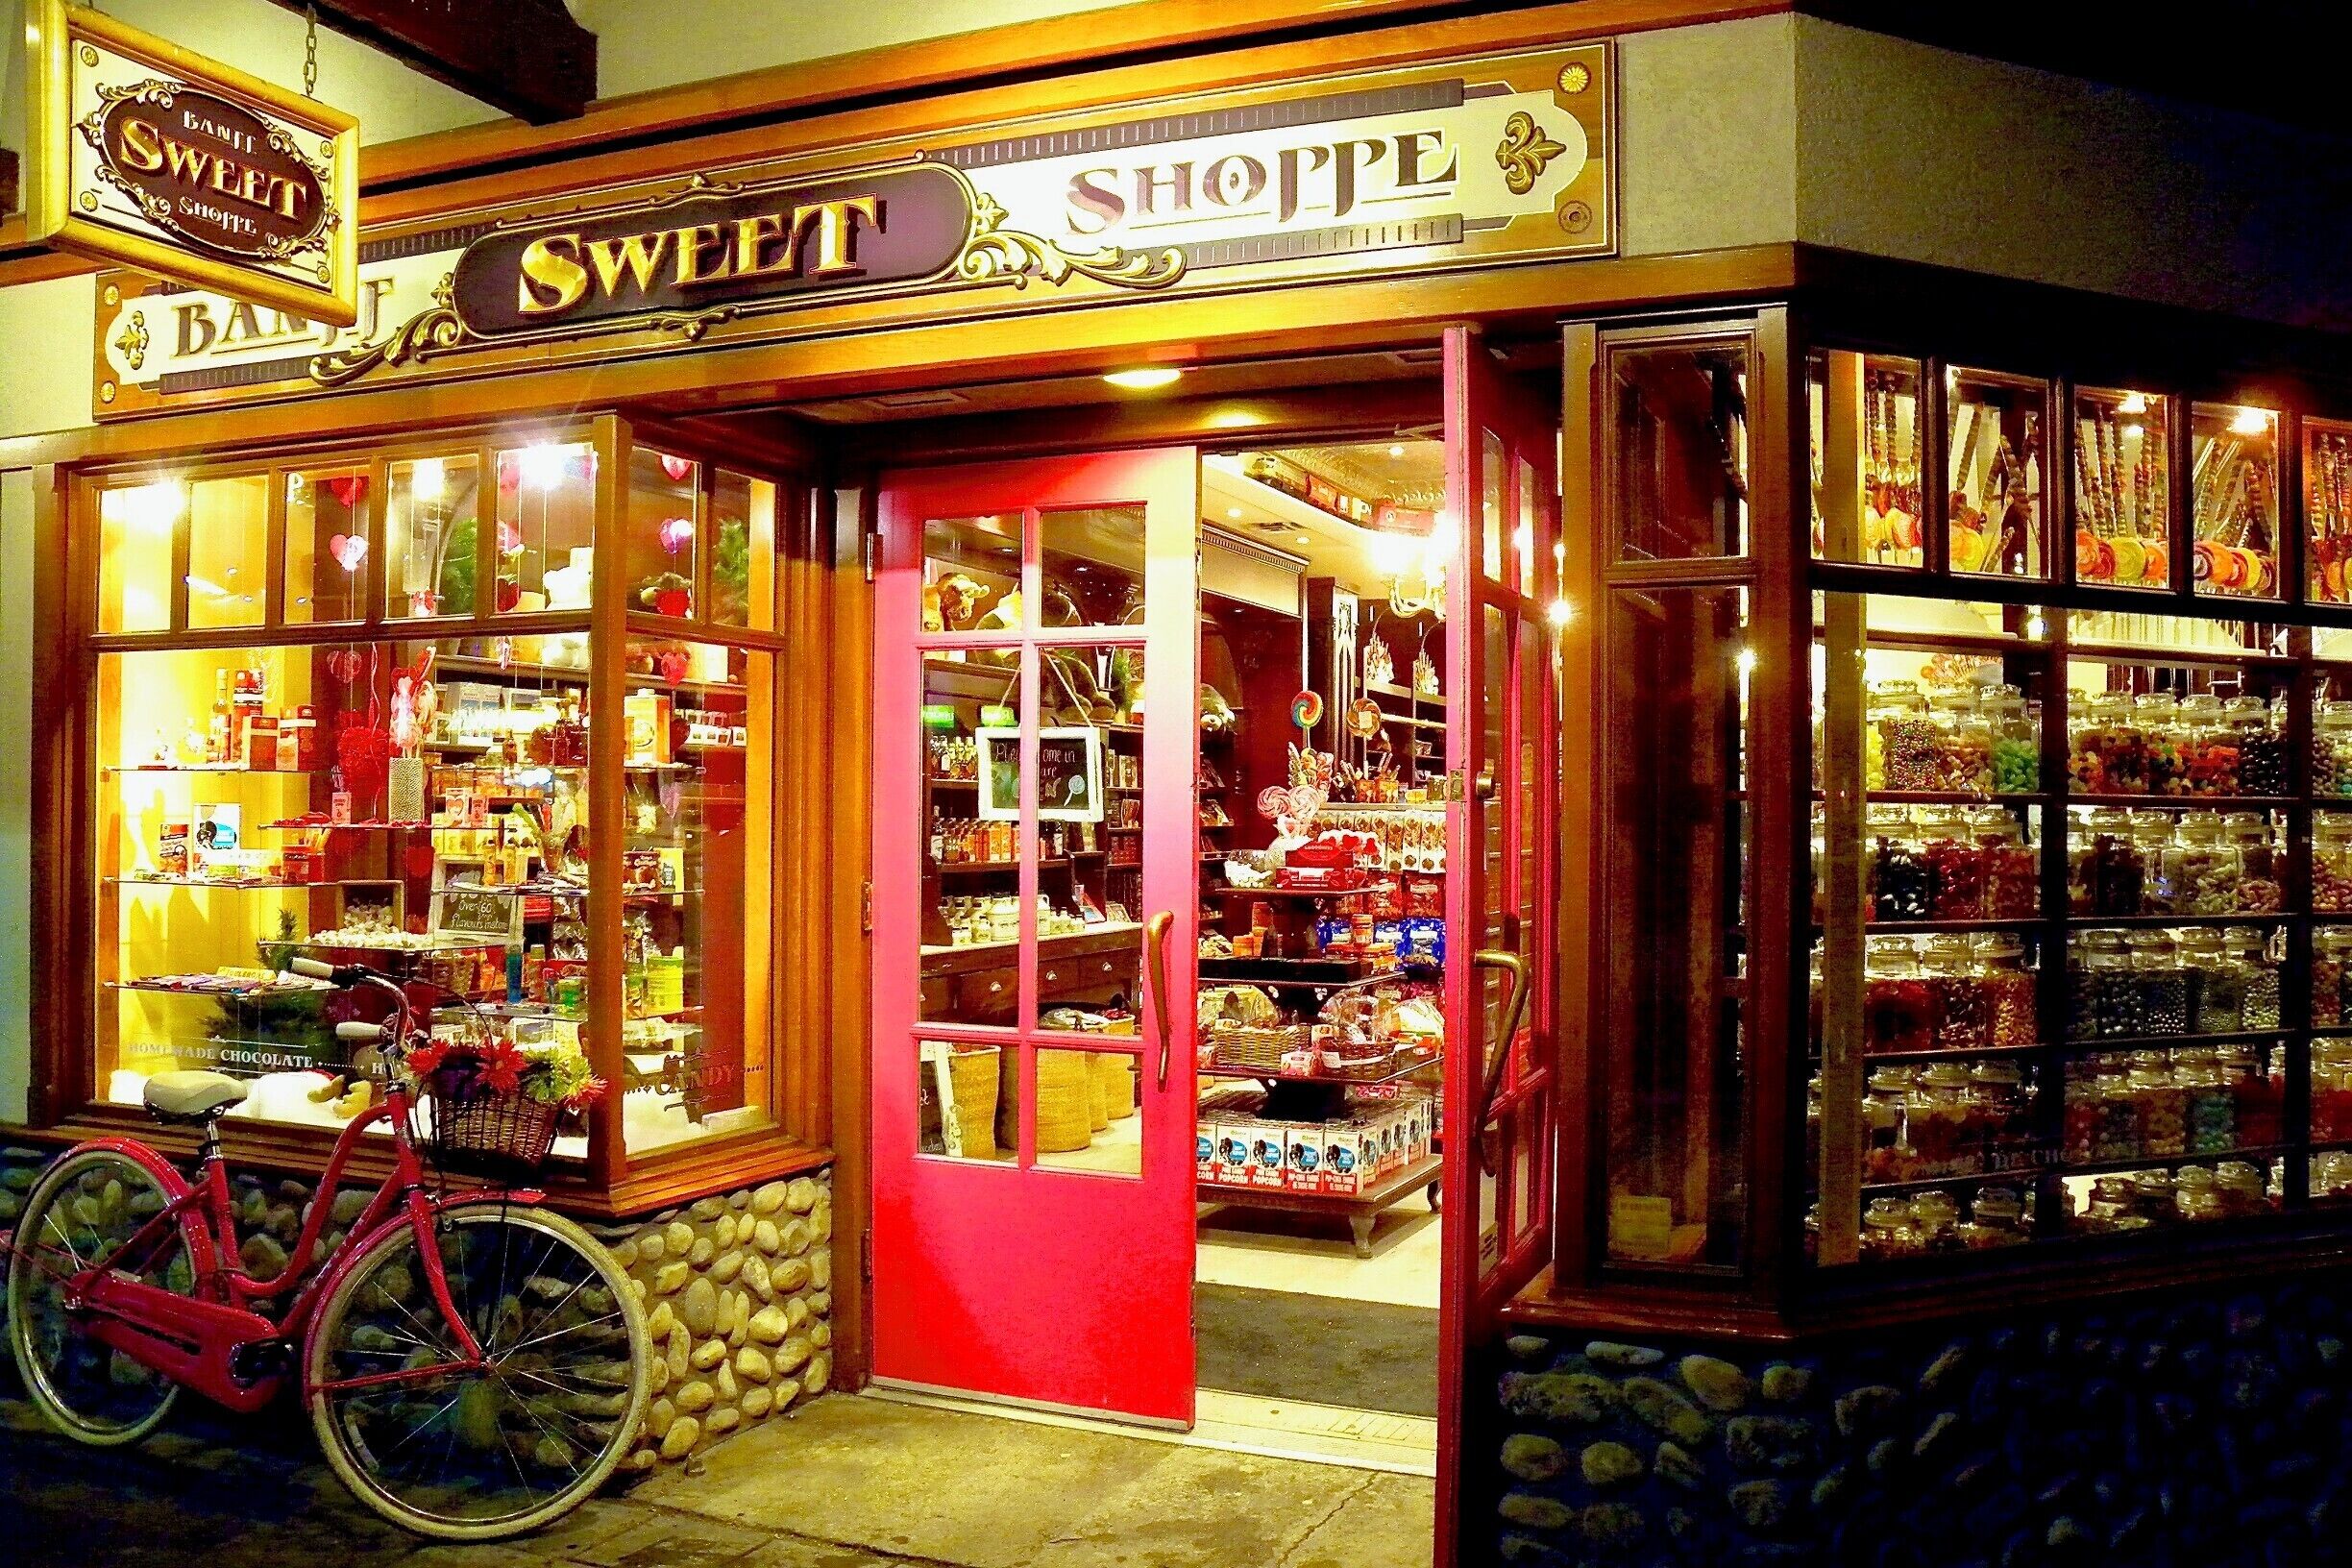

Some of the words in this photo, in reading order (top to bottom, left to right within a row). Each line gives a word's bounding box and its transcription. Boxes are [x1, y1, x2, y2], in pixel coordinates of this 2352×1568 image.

[183, 110, 257, 155] BANFF
[120, 116, 307, 221] SWEET
[178, 196, 257, 234] SHOPPE
[169, 275, 395, 360] BANF
[519, 193, 878, 315] SWEET
[1066, 131, 1458, 234] SHOPPE
[1042, 747, 1061, 764] ome
[220, 1049, 313, 1068] CHOCOLATE
[1218, 1172, 1249, 1185] POPCORN
[1252, 1174, 1283, 1188] POPCORN
